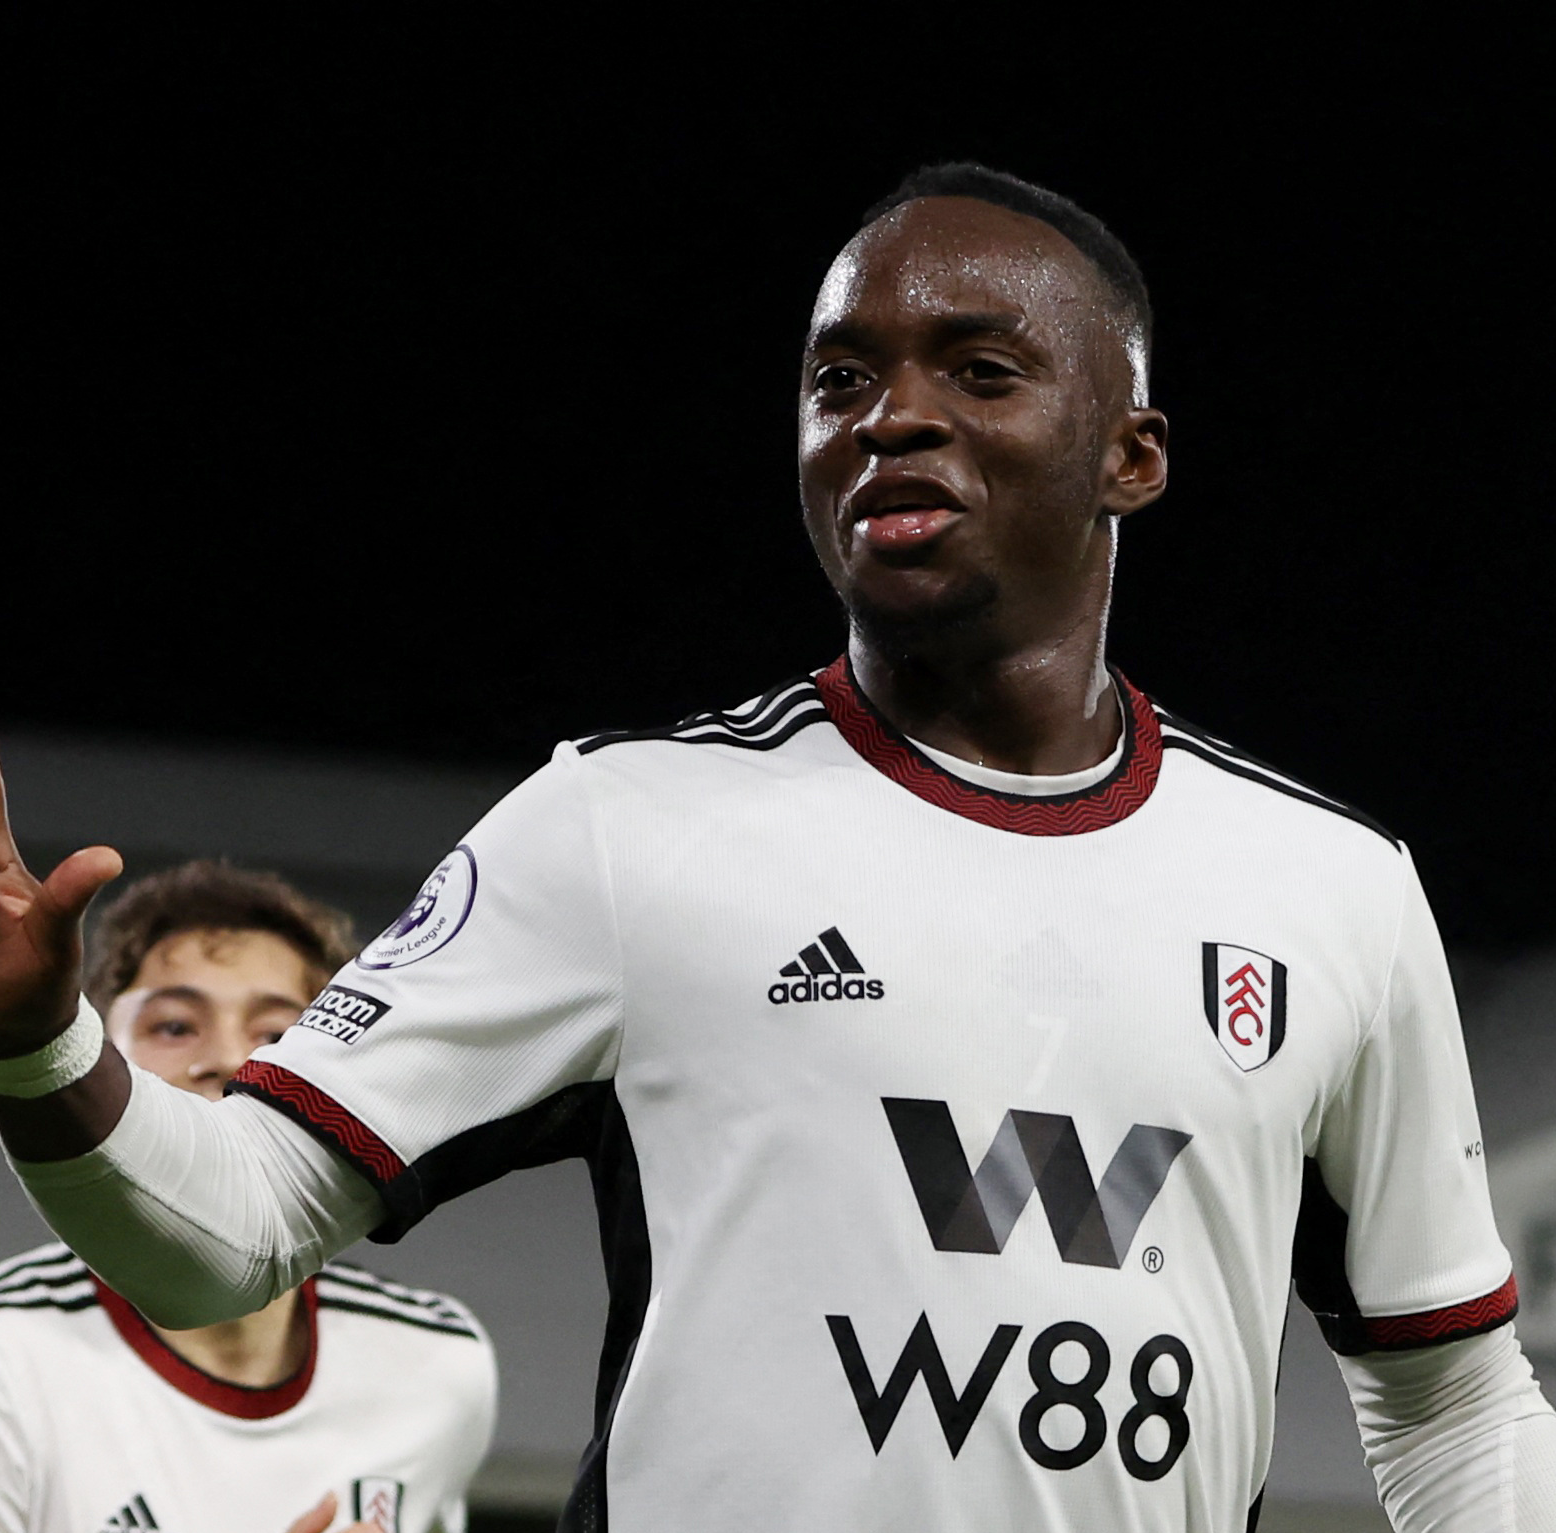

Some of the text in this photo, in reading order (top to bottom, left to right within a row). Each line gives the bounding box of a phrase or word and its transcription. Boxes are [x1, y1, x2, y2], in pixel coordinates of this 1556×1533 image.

[407, 916, 447, 952] League
[767, 974, 885, 1005] adidas
[1225, 961, 1267, 1047] FFC
[824, 1310, 1194, 1482] W88
